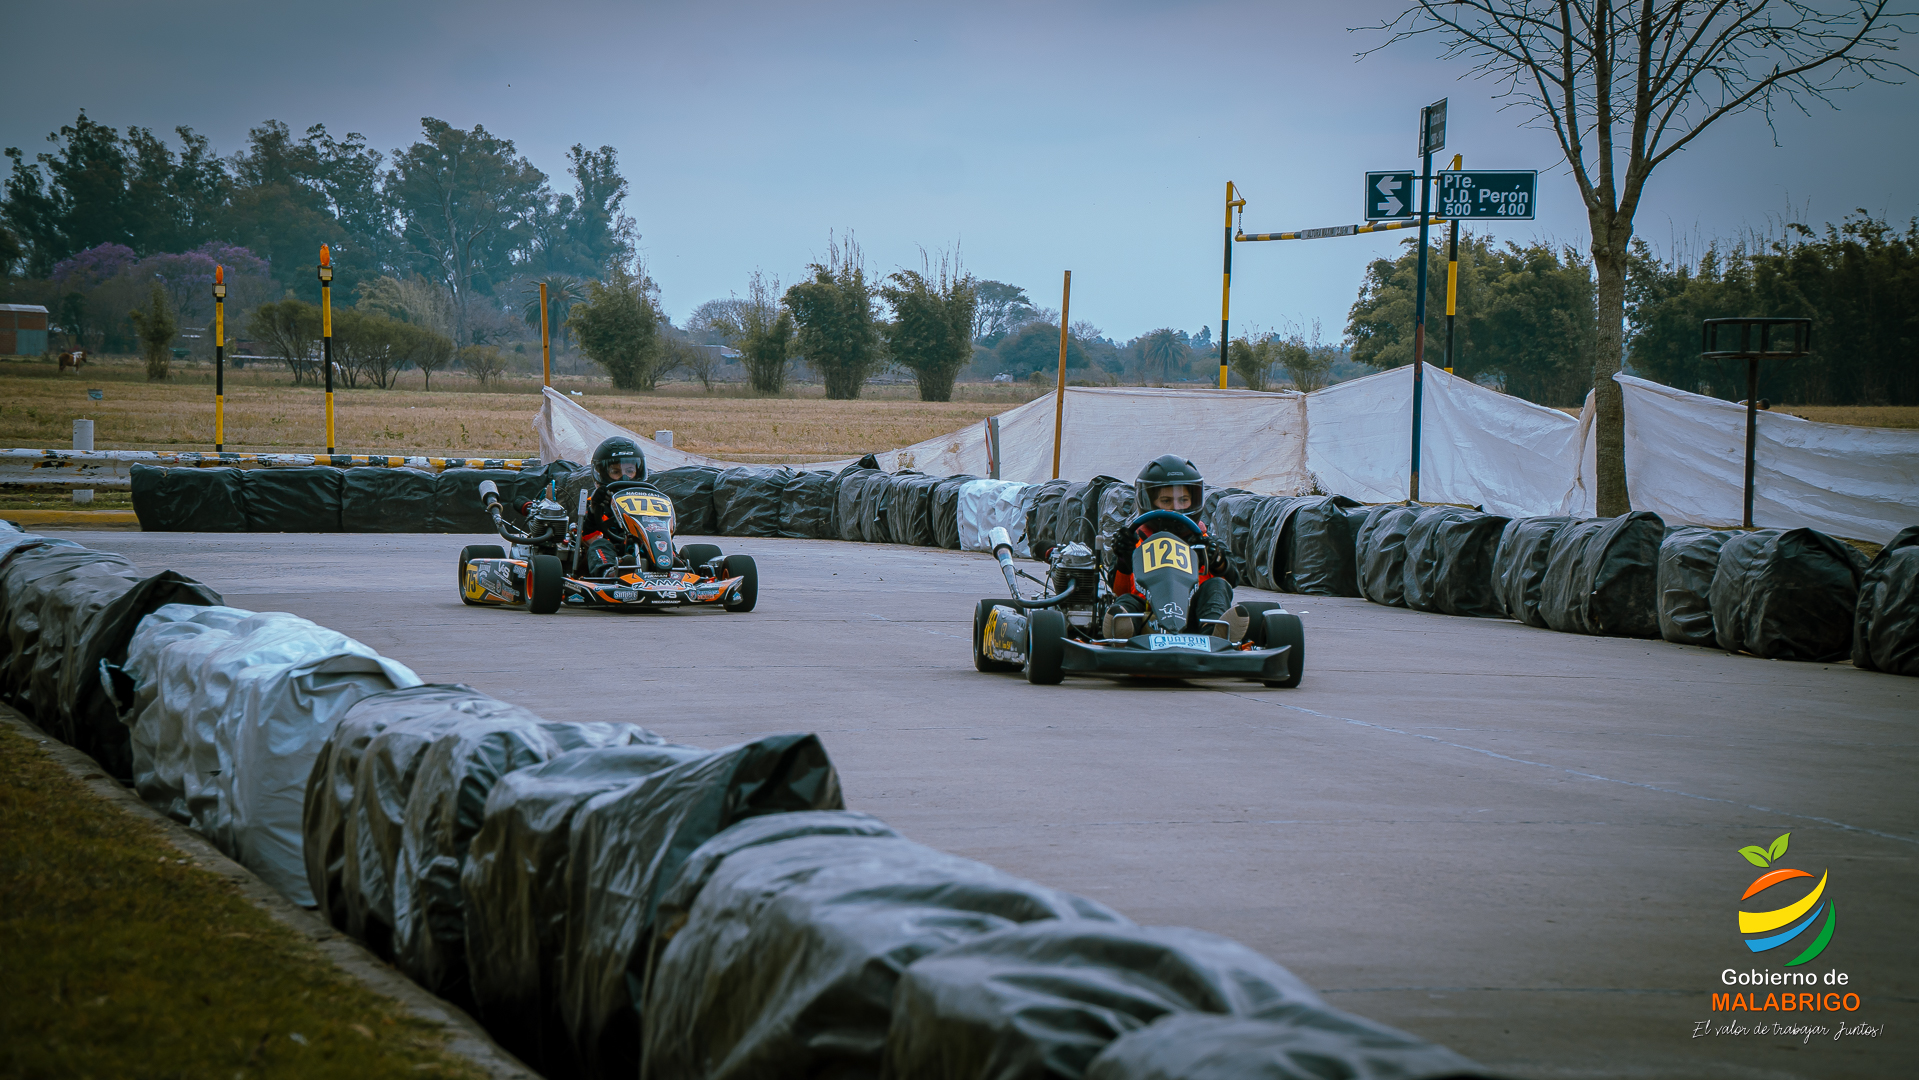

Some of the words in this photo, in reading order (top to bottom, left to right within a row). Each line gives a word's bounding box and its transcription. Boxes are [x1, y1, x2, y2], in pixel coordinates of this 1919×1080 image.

[1443, 174, 1476, 188] PTe.
[1443, 188, 1472, 203] J.D.
[1479, 184, 1529, 203] Perón
[1445, 203, 1471, 216] 500
[1496, 203, 1526, 216] 400
[621, 498, 669, 513] 175
[1145, 539, 1190, 570] 125
